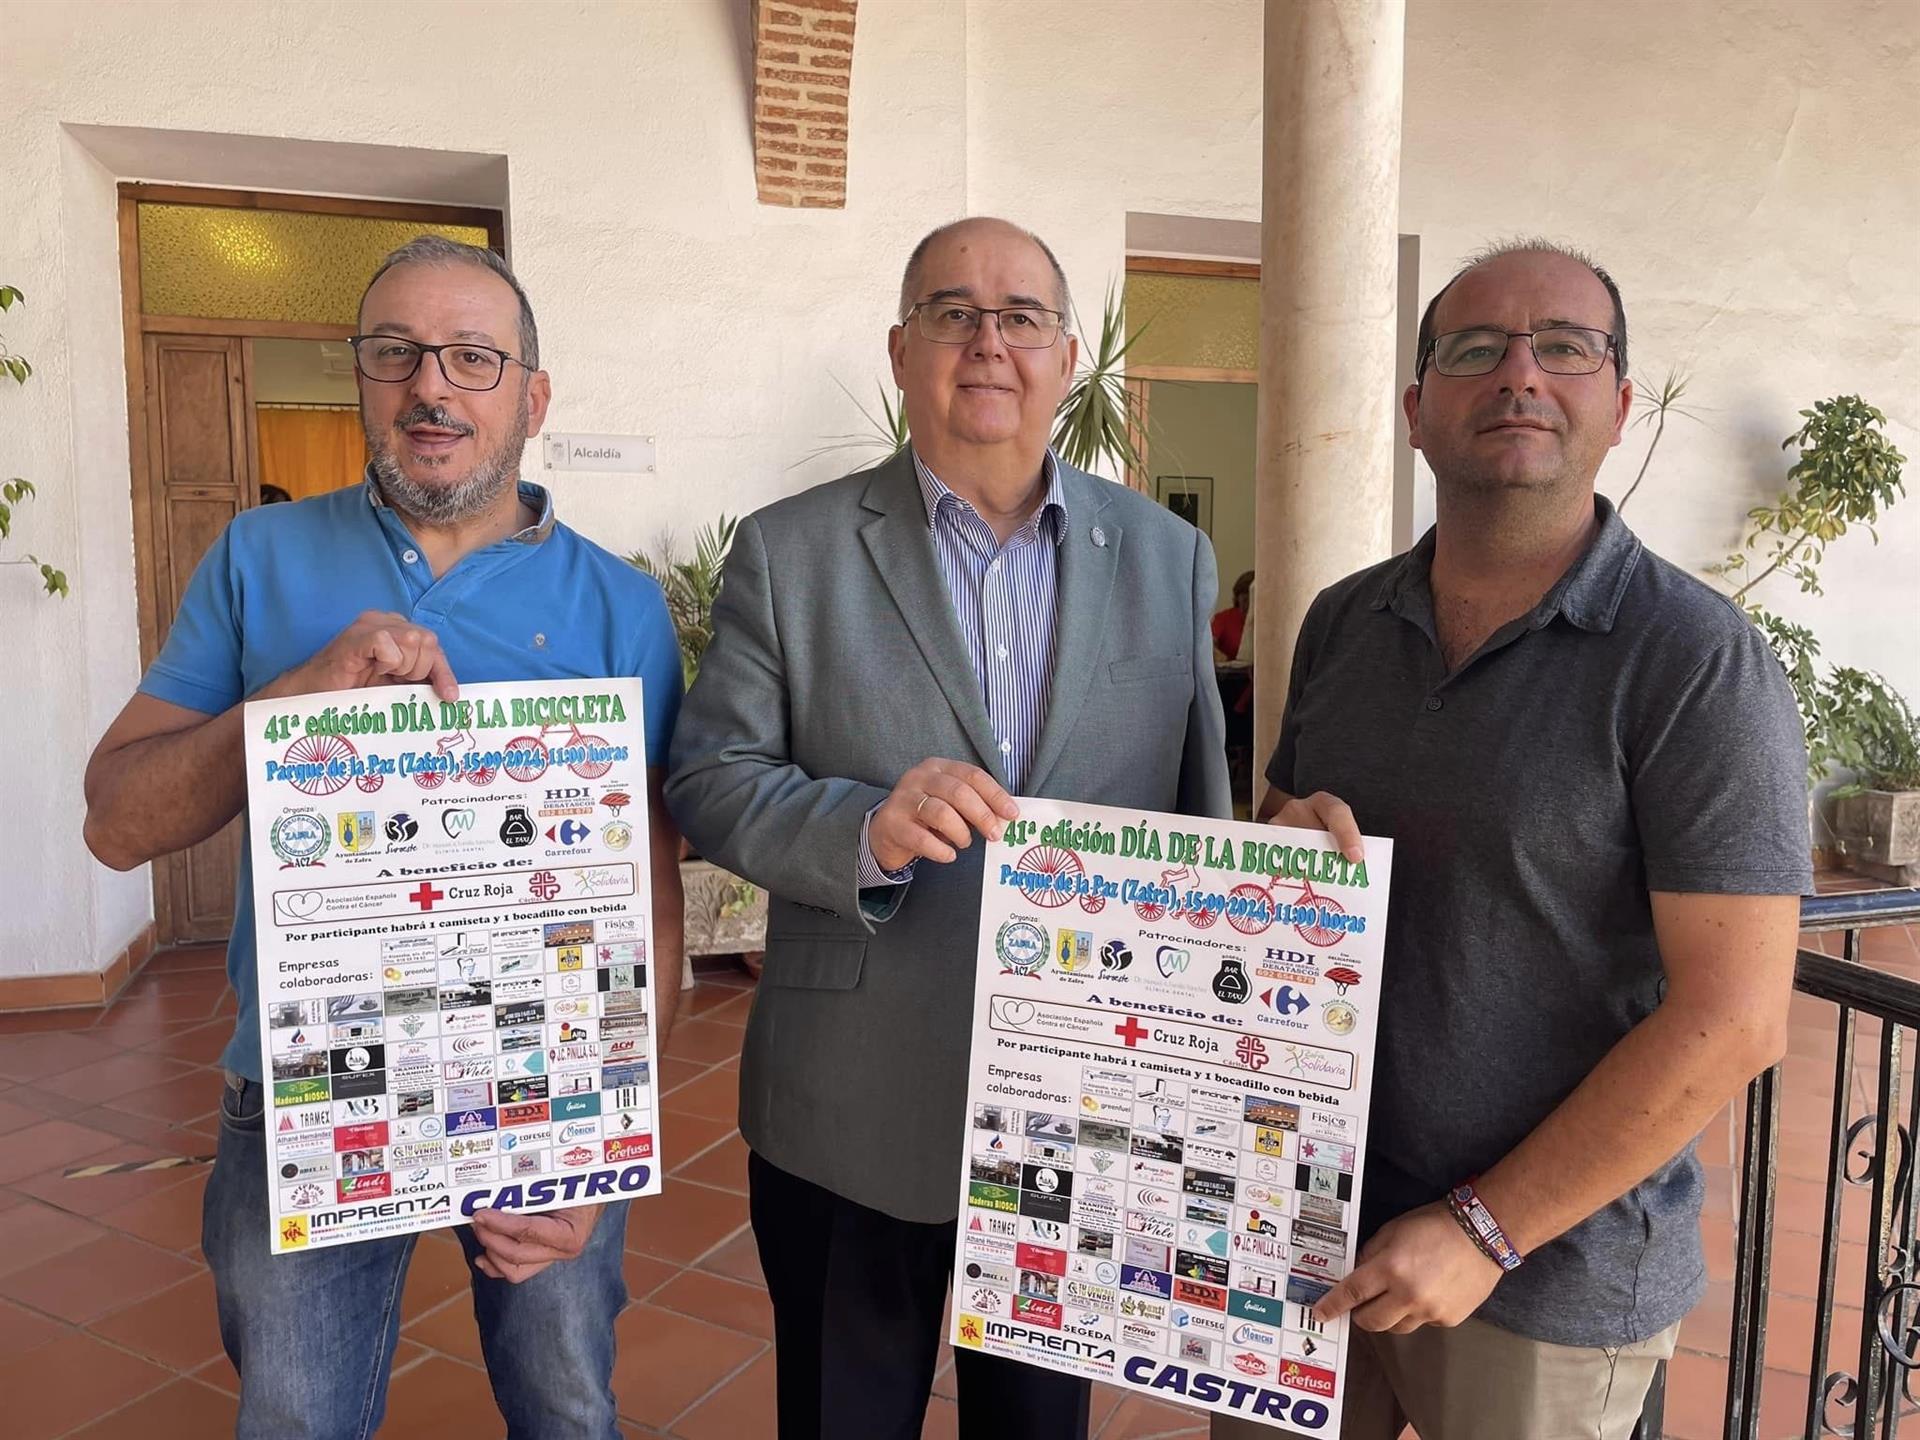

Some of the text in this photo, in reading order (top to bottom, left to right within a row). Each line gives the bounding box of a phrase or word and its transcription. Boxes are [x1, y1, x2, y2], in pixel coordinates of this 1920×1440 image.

[574, 448, 621, 459] Alcaldía
[264, 694, 627, 743] 41ª edición DÍA DE LA BICICLETA
[266, 744, 628, 784] Parque de la Paz (Zafra), 15-09-2024, 11:00 horas
[422, 793, 527, 806] Patrocinadores:
[545, 787, 590, 799] HDI
[544, 801, 595, 809] DESATASCOS
[335, 850, 381, 858] Ayuntamiento
[545, 848, 592, 856] Carrefour
[1003, 819, 1369, 888] 41ª edición DÍA DE LA BICICLETA
[295, 858, 310, 868] ACZ
[376, 859, 533, 877] A beneficio de:
[326, 893, 397, 904] Asociación Española
[449, 884, 513, 900] Cruz Roja
[1000, 864, 1366, 933] Parque de la Paz (Zafra), 15-09-2024, 11:00 horas
[359, 901, 383, 909] Cáncer
[285, 932, 307, 942] Por
[311, 924, 388, 941] participante
[391, 919, 426, 931] habrá
[439, 917, 490, 927] camiseta
[493, 916, 501, 924] y
[504, 914, 509, 922] 1
[513, 909, 565, 920] bocadillo
[568, 907, 587, 916] con
[590, 903, 627, 913] bebida
[1139, 930, 1247, 952] Patrocinadores:
[1265, 948, 1316, 965] HDI
[279, 959, 339, 973] Empresas
[1014, 966, 1028, 976] ACZ
[1051, 968, 1094, 979] Ayuntamiento
[1224, 966, 1239, 974] BAR
[1263, 963, 1319, 977] DESATASCOS
[279, 972, 374, 989] colaboradoras:
[1227, 992, 1243, 1000] TAXI
[1087, 995, 1243, 1026] A beneficio de:
[1036, 1019, 1058, 1028] Contra
[1066, 1022, 1089, 1032] Cáncer
[1037, 1012, 1103, 1027] Asociación Española
[1257, 1014, 1309, 1030] Carrefour
[611, 1041, 635, 1051] ACM
[1154, 1029, 1219, 1053] Cruz Roja
[988, 1064, 1042, 1082] Empresas
[997, 1038, 1017, 1049] Por
[1020, 1043, 1091, 1061] participante
[1094, 1053, 1128, 1067] habrá
[1141, 1062, 1191, 1077] camiseta
[1194, 1071, 1202, 1080] y
[1205, 1071, 1211, 1079] 1
[1215, 1070, 1270, 1092] bocadillo
[1273, 1086, 1295, 1097] con
[1299, 1090, 1340, 1106] bebida
[275, 1091, 329, 1105] Maderas BIOSCA
[986, 1083, 1072, 1104] colaboradoras:
[520, 1132, 551, 1141] COFESEG
[606, 1144, 649, 1161] Grefusa
[394, 1182, 444, 1195] SEGEDA
[311, 1165, 651, 1228] IMPRENTA CASTRO
[969, 1195, 1017, 1211] Maderas BIOSCA
[1301, 1253, 1329, 1267] ACM
[1191, 1316, 1225, 1330] COFESEG
[1064, 1325, 1113, 1342] SEGEDA
[986, 1321, 1115, 1363] IMPRENTA
[1123, 1356, 1329, 1429] CASTRO
[1281, 1371, 1332, 1390] Grefusa
